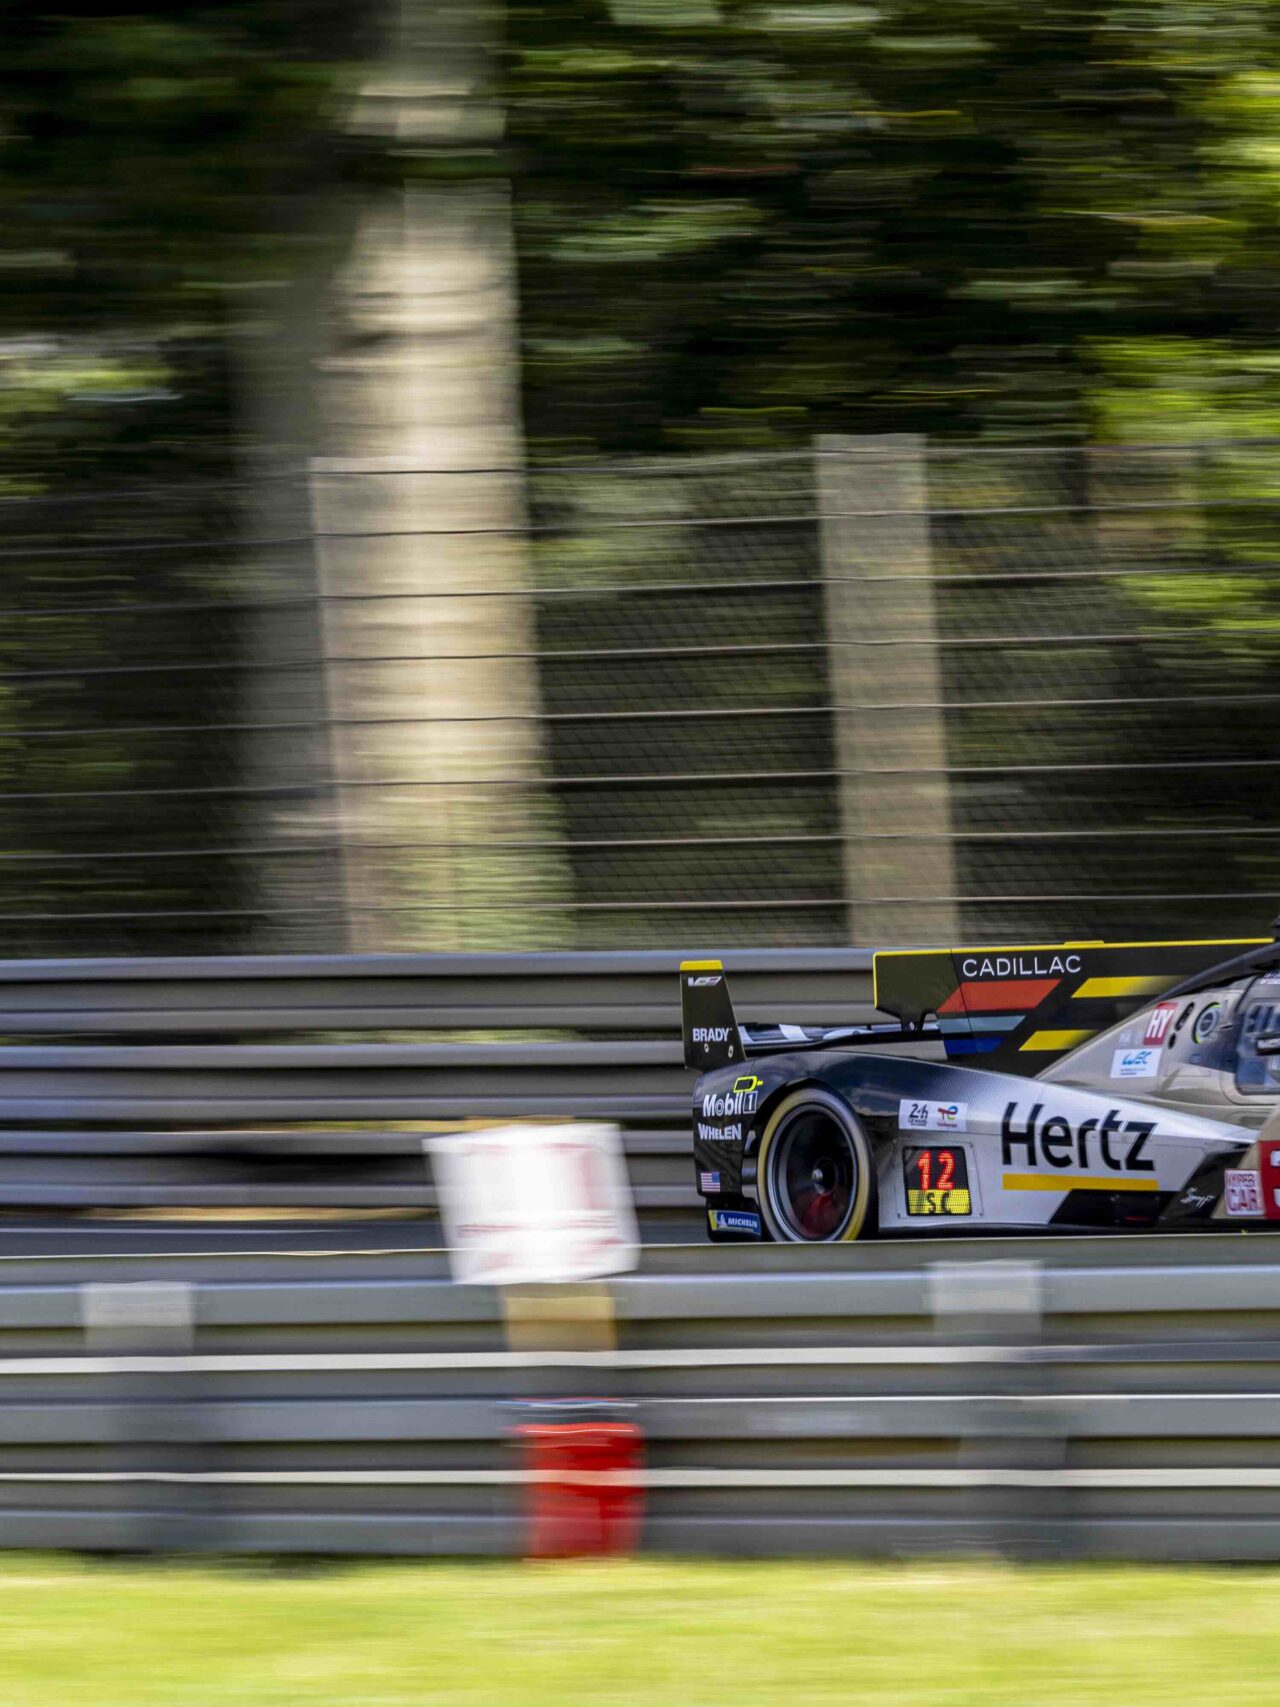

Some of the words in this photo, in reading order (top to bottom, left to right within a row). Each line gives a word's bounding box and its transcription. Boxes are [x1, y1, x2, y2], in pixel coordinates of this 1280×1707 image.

[963, 955, 1081, 977] CADILLAC
[1146, 1008, 1176, 1038] HY
[692, 1027, 729, 1042] BRADY
[703, 1092, 743, 1117] Mobil
[698, 1122, 742, 1140] WHELEN
[1001, 1102, 1158, 1172] Hertz
[917, 1151, 955, 1190] 12
[926, 1192, 952, 1214] SC
[727, 1217, 758, 1229] MICHELIN
